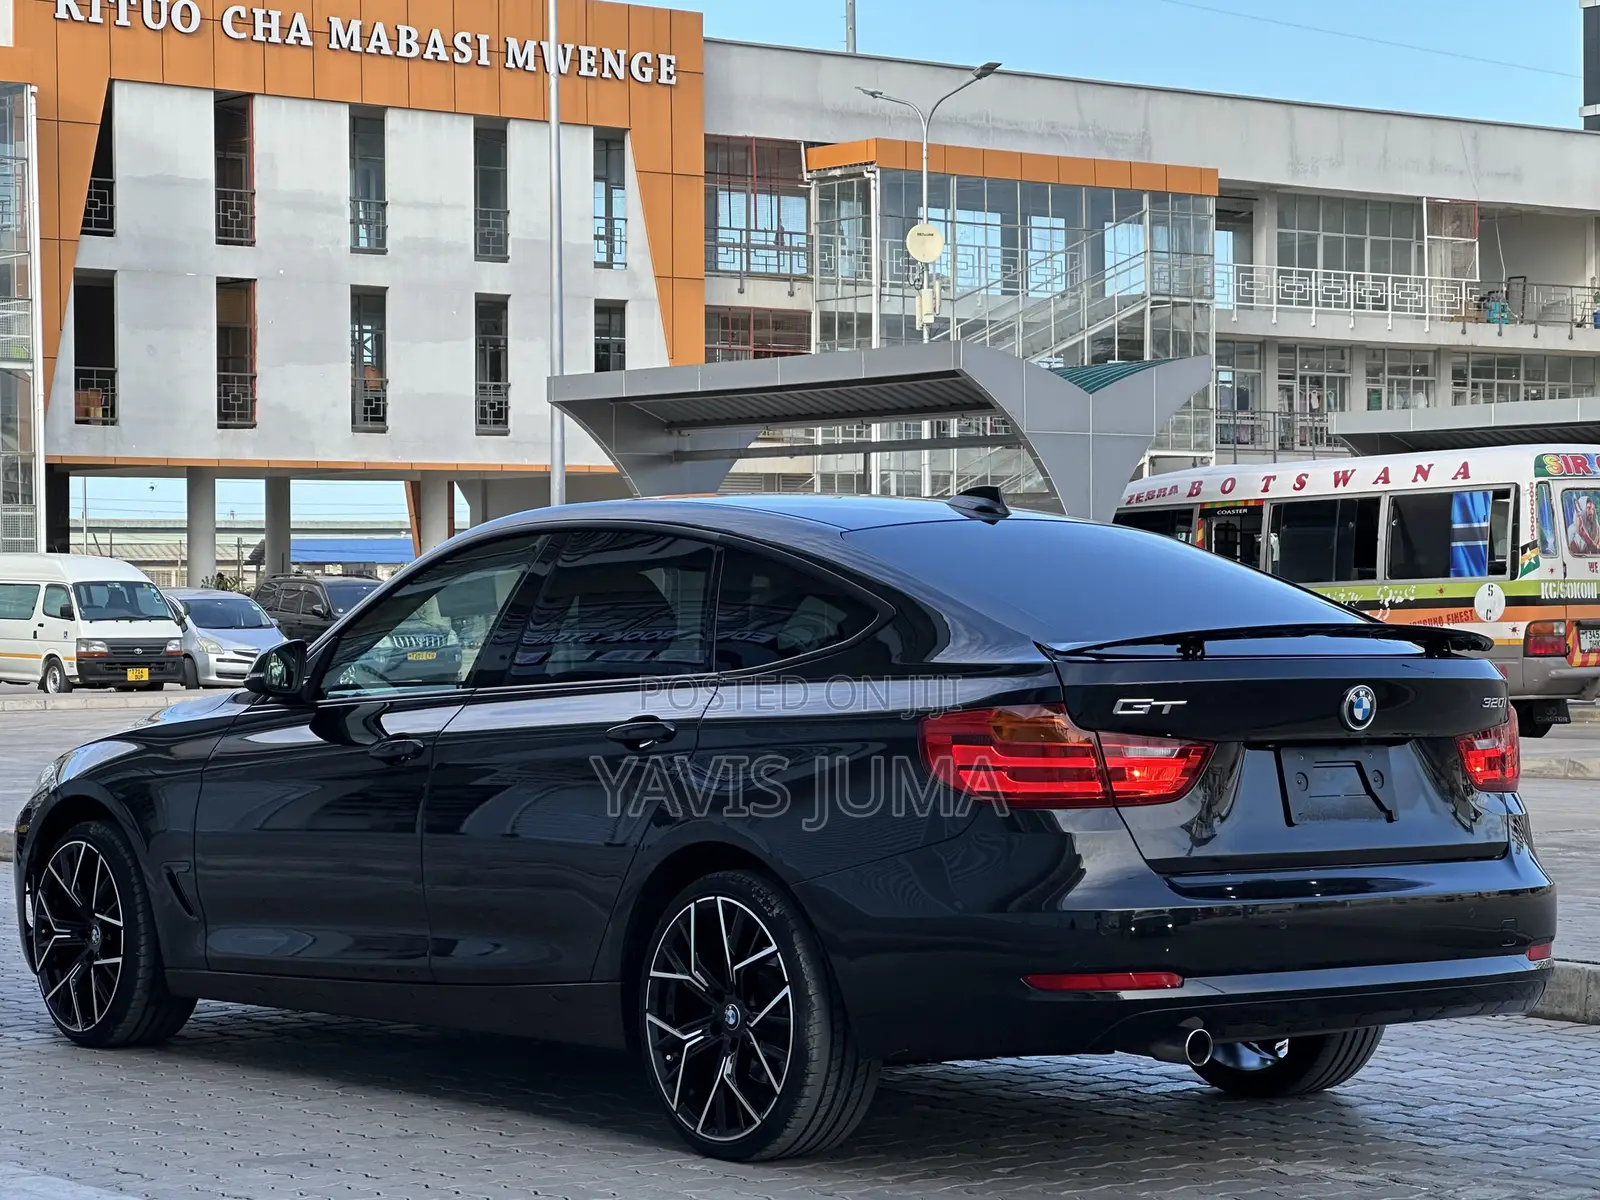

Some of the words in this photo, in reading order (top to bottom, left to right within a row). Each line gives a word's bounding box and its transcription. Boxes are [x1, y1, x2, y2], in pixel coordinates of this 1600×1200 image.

[54, 0, 201, 34] KITUO
[221, 5, 314, 47] CHA
[327, 16, 490, 67] MABASI
[504, 36, 678, 86] MWENGE
[1543, 454, 1593, 476] SIR
[1125, 484, 1179, 506] ZEBRA
[1186, 461, 1471, 498] BOTSWANA
[1216, 508, 1248, 516] COASTER
[1112, 698, 1188, 715] GT
